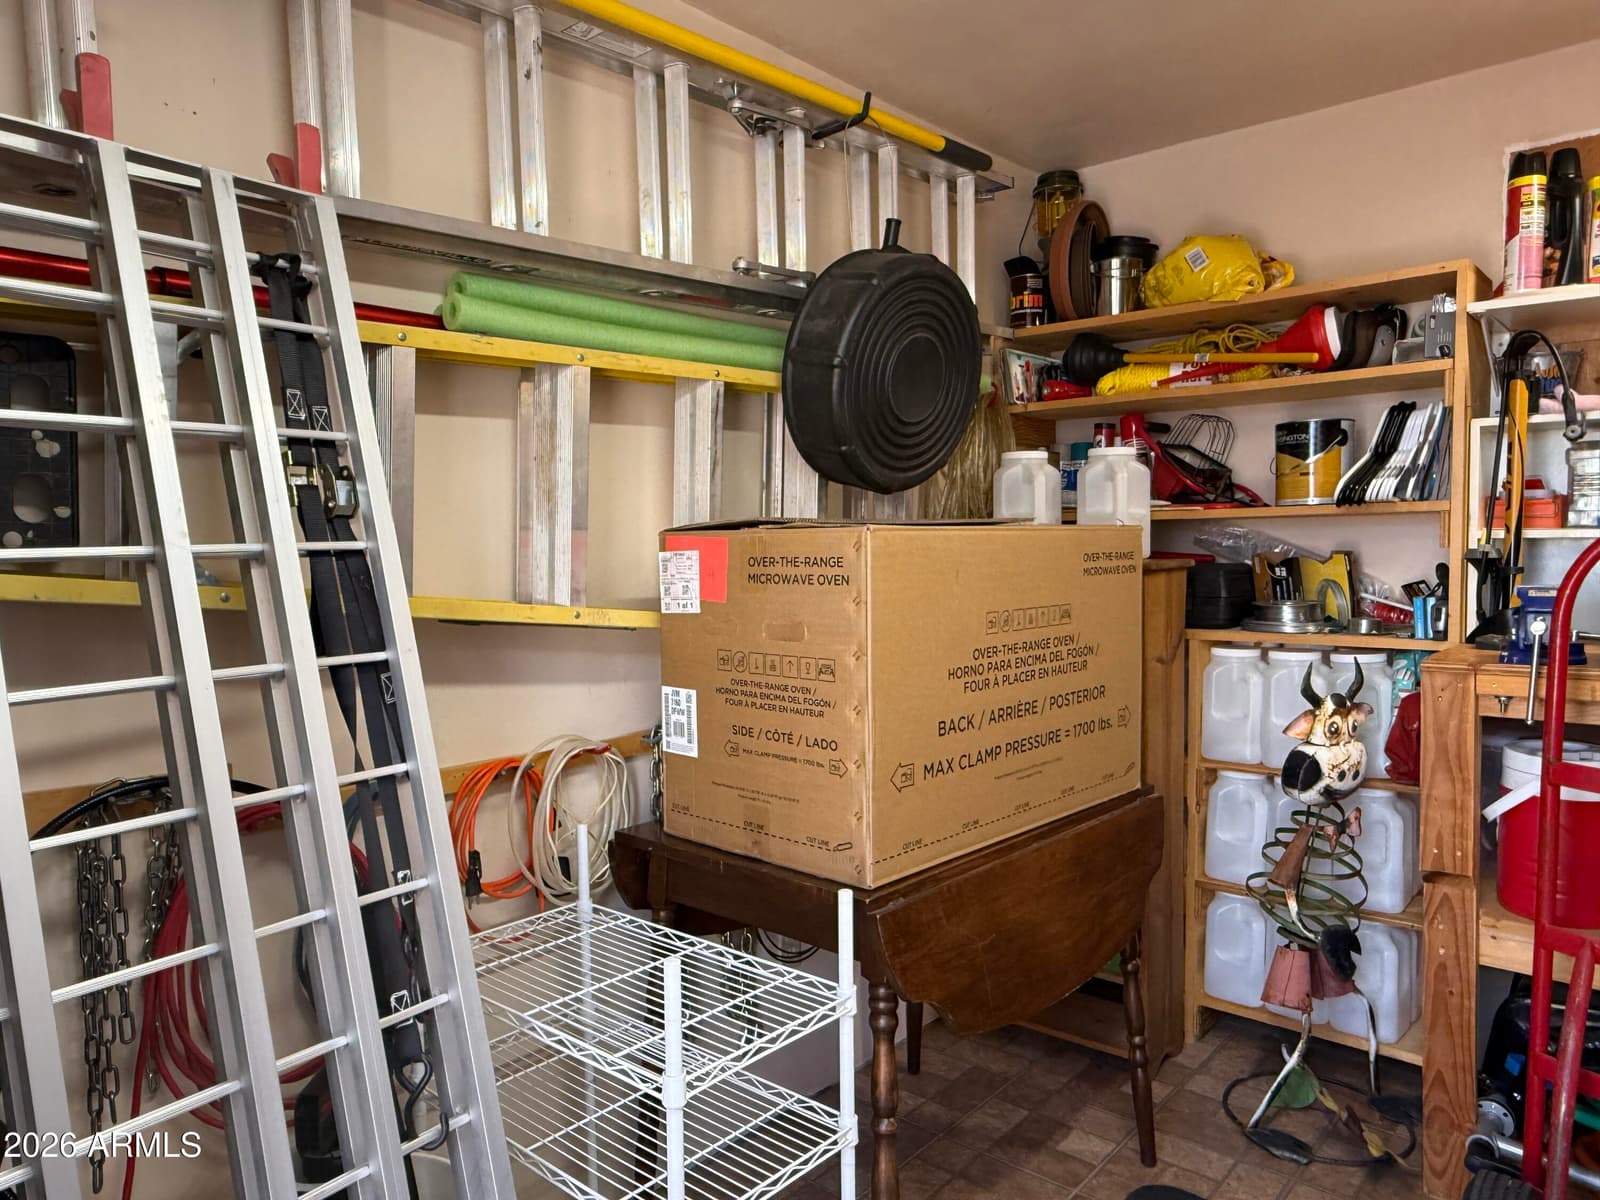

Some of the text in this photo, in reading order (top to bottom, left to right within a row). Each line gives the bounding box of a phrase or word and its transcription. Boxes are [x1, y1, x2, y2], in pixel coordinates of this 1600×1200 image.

[747, 556, 844, 568] OVER-THE-RANGE
[1082, 551, 1135, 562] OVER-THE-RANGE
[747, 573, 850, 586] MICROWAVE OVEN
[1083, 564, 1137, 577] MICROWAVE OVEN
[972, 637, 1051, 661] OVER-THE-RANGE
[1052, 633, 1075, 648] OVEN
[948, 662, 985, 680] HORNO
[987, 657, 1012, 673] PARA
[1014, 652, 1048, 669] ENCIMA
[1049, 650, 1065, 663] DEL
[1066, 644, 1095, 660] FOGÓN
[730, 678, 790, 692] OVER-THE-RANGE
[790, 685, 812, 695] OVEN
[963, 659, 1089, 694] FOUR À PLACER EN HAUTEUR
[715, 687, 740, 697] HORNO
[740, 689, 759, 700] PARA
[759, 691, 786, 703] ENCIMA
[787, 695, 803, 705] DEL
[803, 697, 831, 709] FOGÓN
[725, 698, 743, 708] FOUR
[750, 702, 777, 712] PLACER
[778, 705, 789, 713] EN
[789, 706, 825, 719] HAUTEUR
[938, 713, 975, 737] BACK
[988, 700, 1039, 726] ARRIÈRE
[1049, 684, 1106, 711] POSTERIOR
[731, 724, 755, 738] SIDE
[764, 728, 794, 745] CÔTÉ
[805, 736, 838, 752] LADO
[753, 750, 771, 758] CLAMP
[771, 753, 797, 763] PRESSURE
[923, 757, 955, 781] MAX
[958, 745, 1003, 770] CLAMP
[1005, 728, 1062, 758] PRESSURE
[1073, 720, 1096, 739] 1700
[1098, 717, 1113, 731] lbs.
[806, 835, 817, 843] CUT
